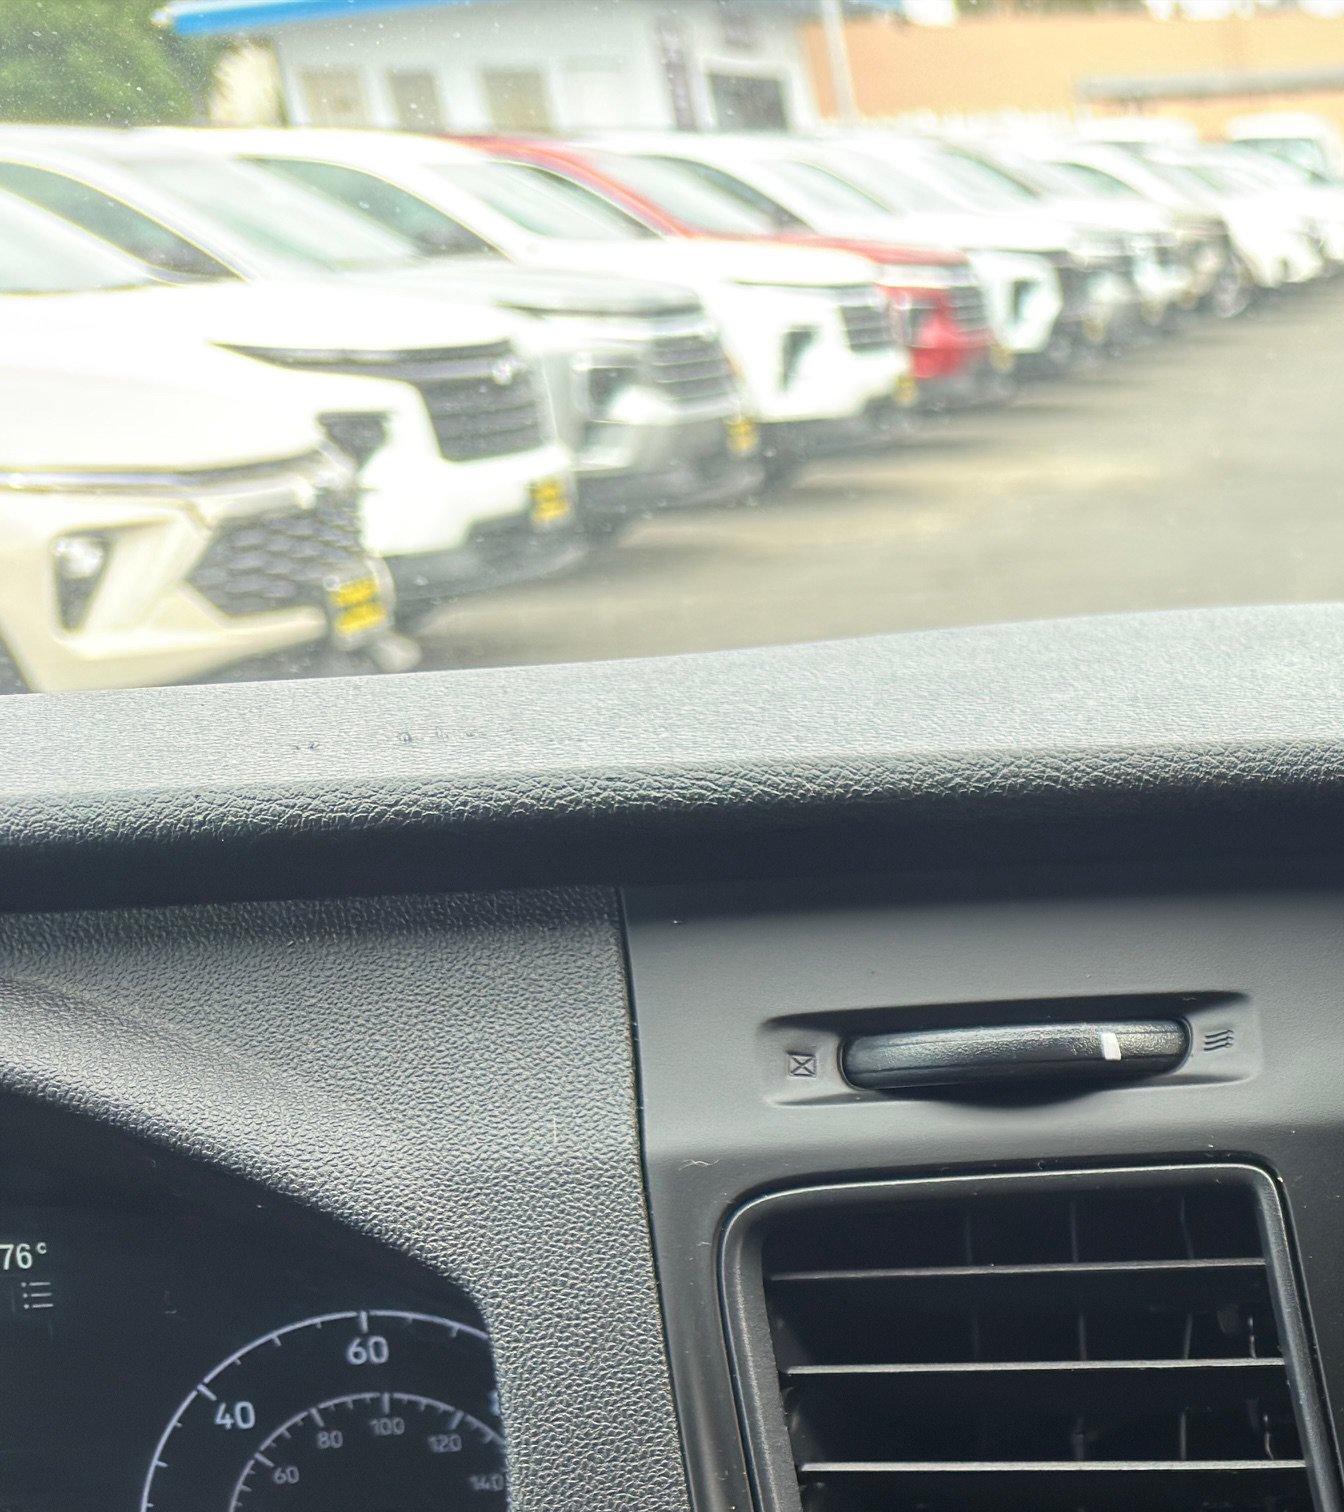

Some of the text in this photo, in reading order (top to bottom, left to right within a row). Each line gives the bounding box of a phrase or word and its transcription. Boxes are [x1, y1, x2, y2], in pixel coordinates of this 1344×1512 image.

[347, 1335, 390, 1365] 60
[213, 1398, 258, 1432] 40
[369, 1415, 406, 1437] 100
[316, 1429, 344, 1450] 80
[427, 1433, 463, 1453] 120
[272, 1463, 301, 1486] 60
